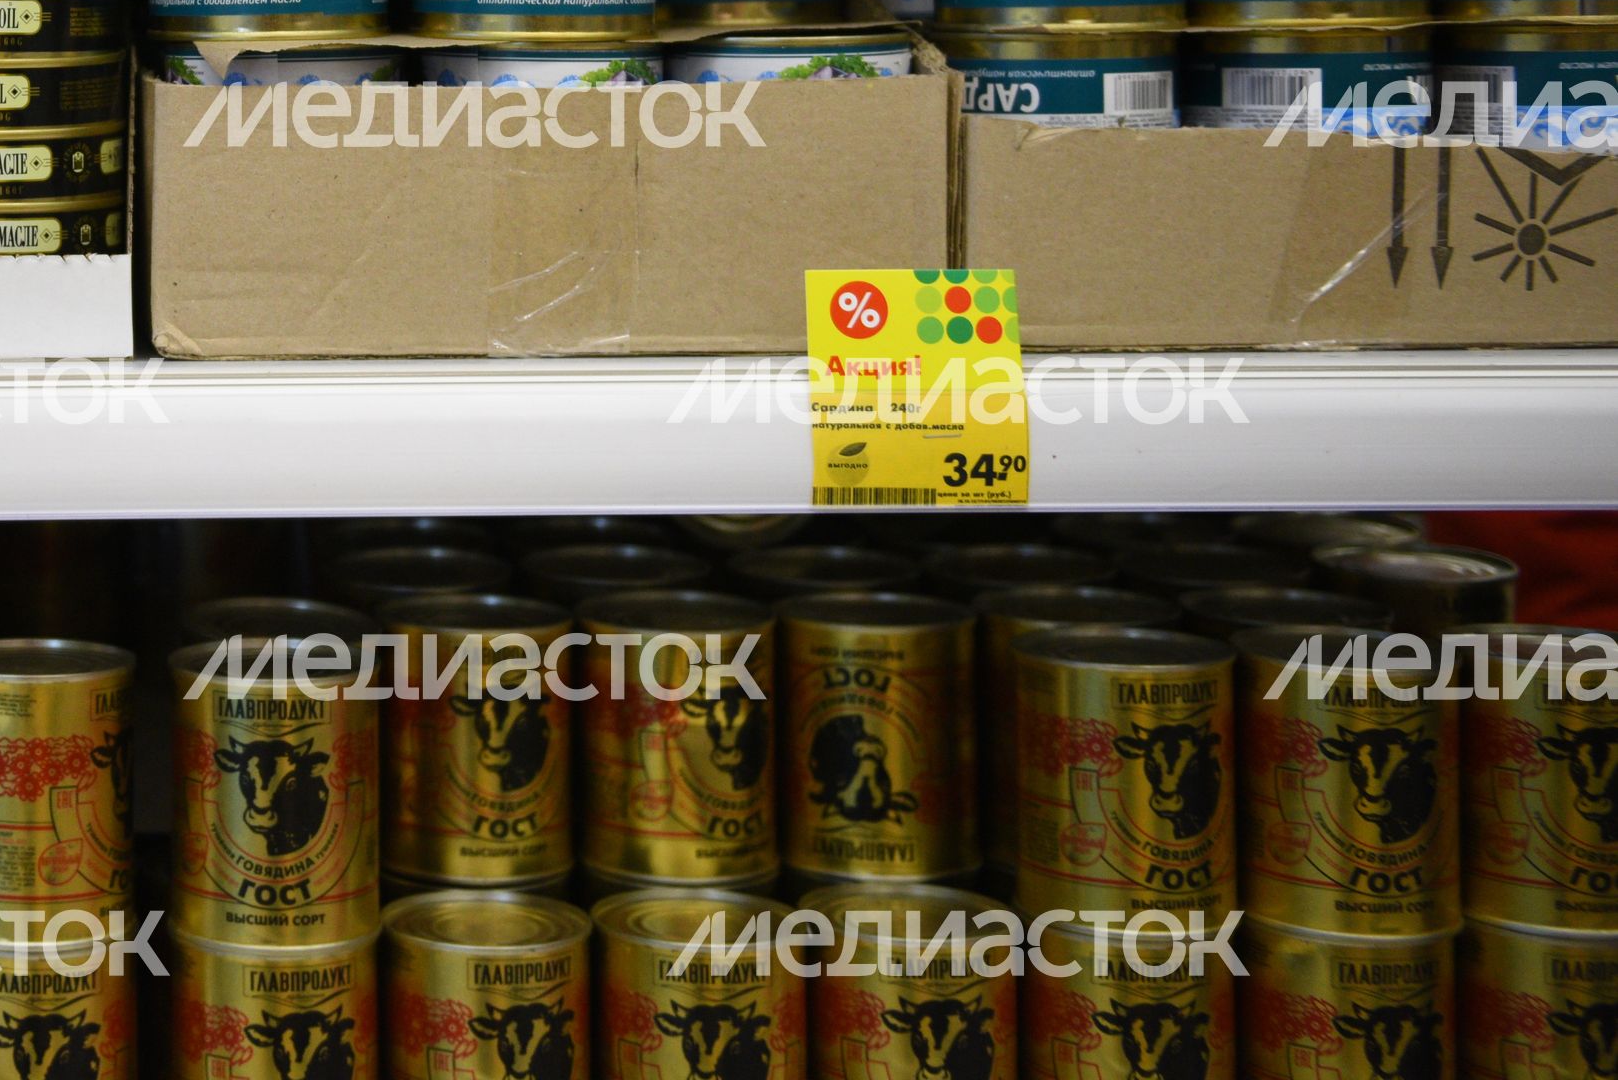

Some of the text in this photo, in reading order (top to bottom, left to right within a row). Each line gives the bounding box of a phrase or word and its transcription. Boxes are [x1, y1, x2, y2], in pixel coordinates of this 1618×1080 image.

[825, 355, 922, 380] Акция!
[811, 402, 874, 415] Сардина
[218, 696, 326, 721] ГЛАВПРОДУКТ
[236, 857, 315, 879] ГОВЯДИНА
[1144, 864, 1212, 891] ГОСТ
[1350, 867, 1423, 894] ГОСТ
[239, 879, 312, 907] ГОСТ
[249, 964, 352, 992] ГЛАВПРОДУКТ
